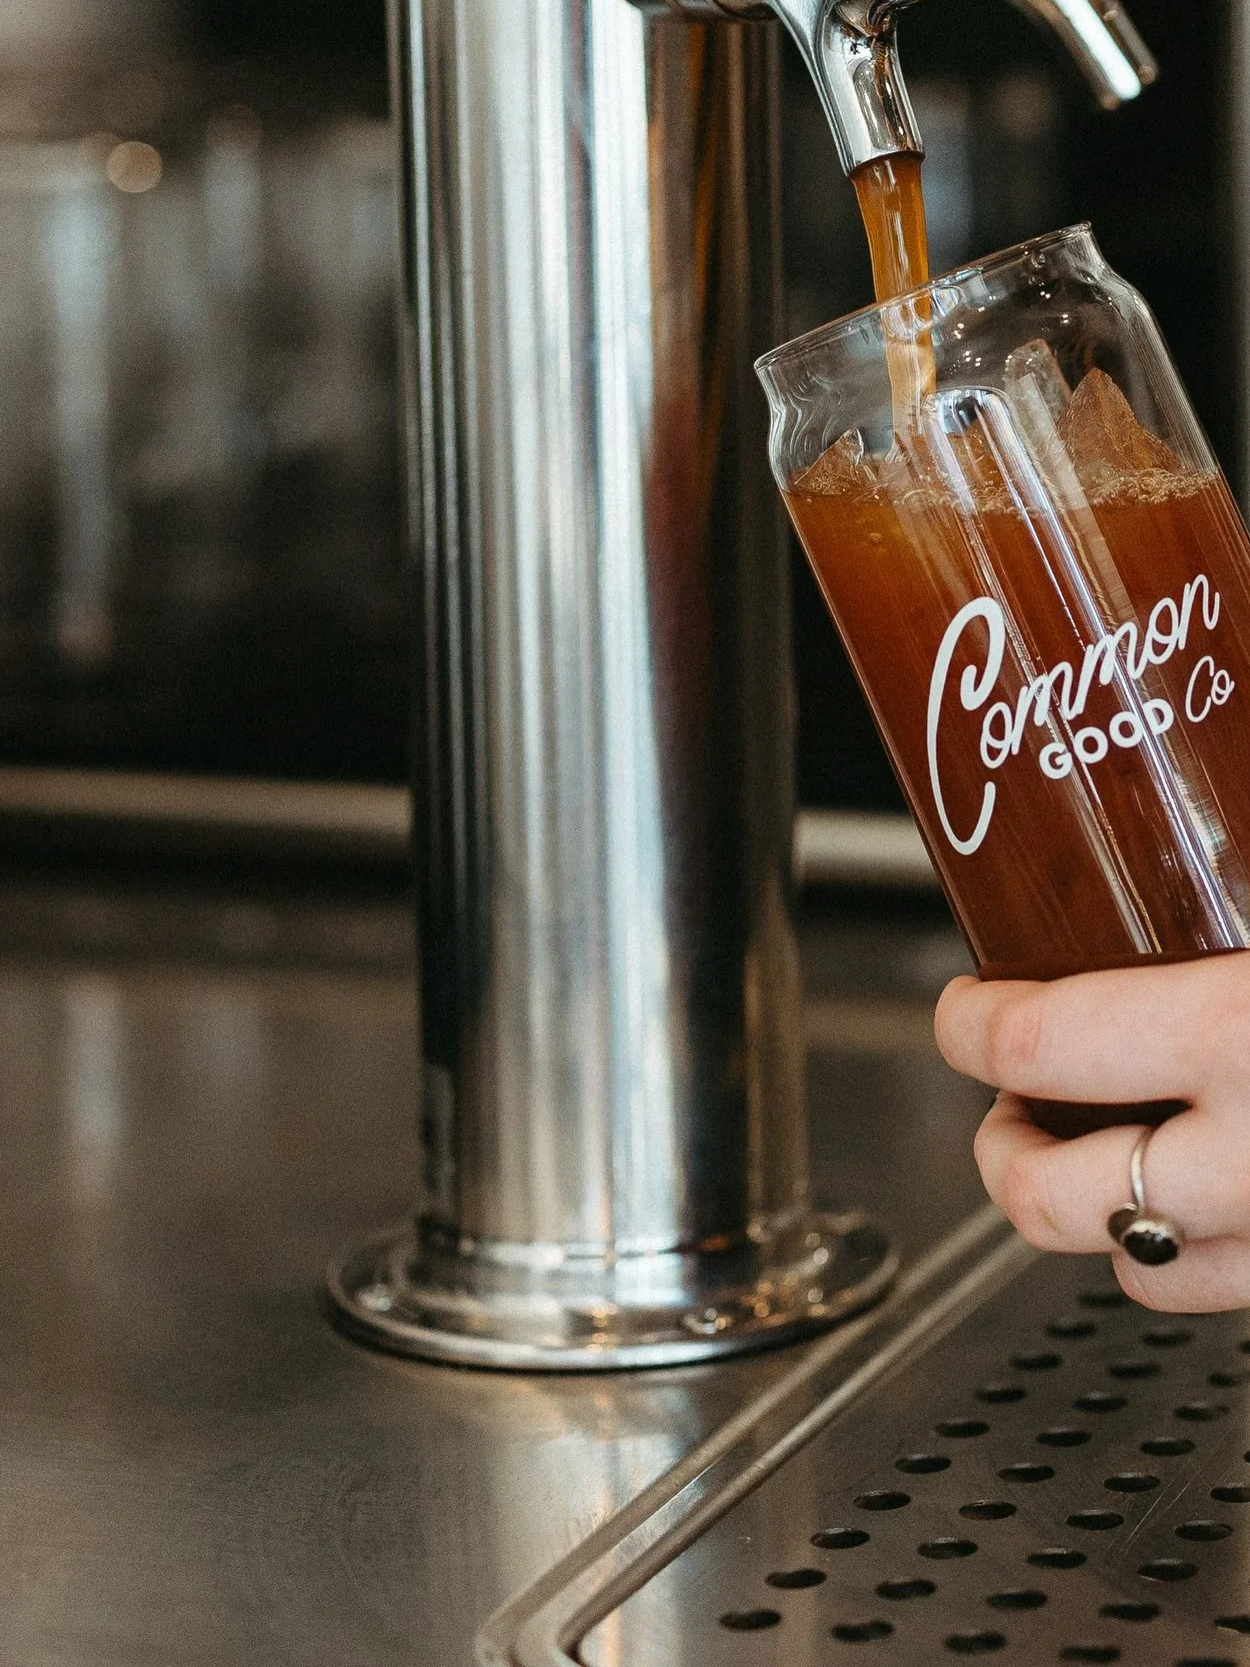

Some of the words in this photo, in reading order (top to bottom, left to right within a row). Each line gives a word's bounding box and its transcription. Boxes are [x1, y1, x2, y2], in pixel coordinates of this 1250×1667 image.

[927, 574, 1220, 855] Common
[1039, 698, 1174, 779] GOOD
[1185, 656, 1235, 723] Co
